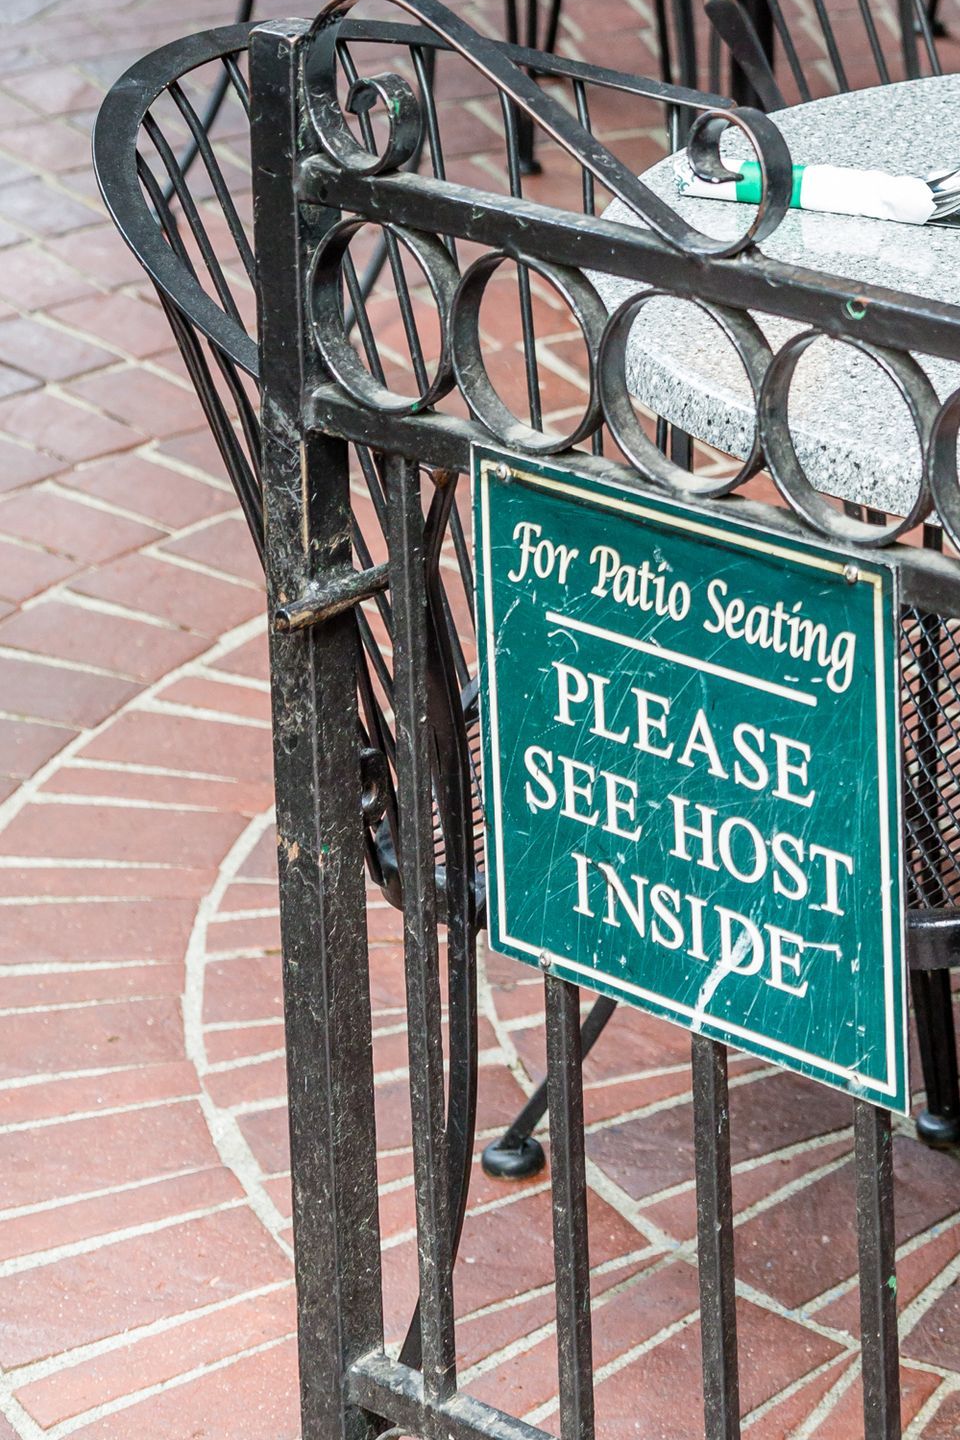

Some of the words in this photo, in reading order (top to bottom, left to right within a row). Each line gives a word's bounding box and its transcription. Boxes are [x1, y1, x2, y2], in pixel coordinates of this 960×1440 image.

[508, 521, 579, 585] For
[589, 544, 691, 622] Patio
[703, 578, 857, 695] Seating
[551, 658, 816, 809] PLEASE
[523, 744, 643, 843] SEE
[667, 793, 854, 917] HOST
[570, 852, 810, 999] INSIDE
